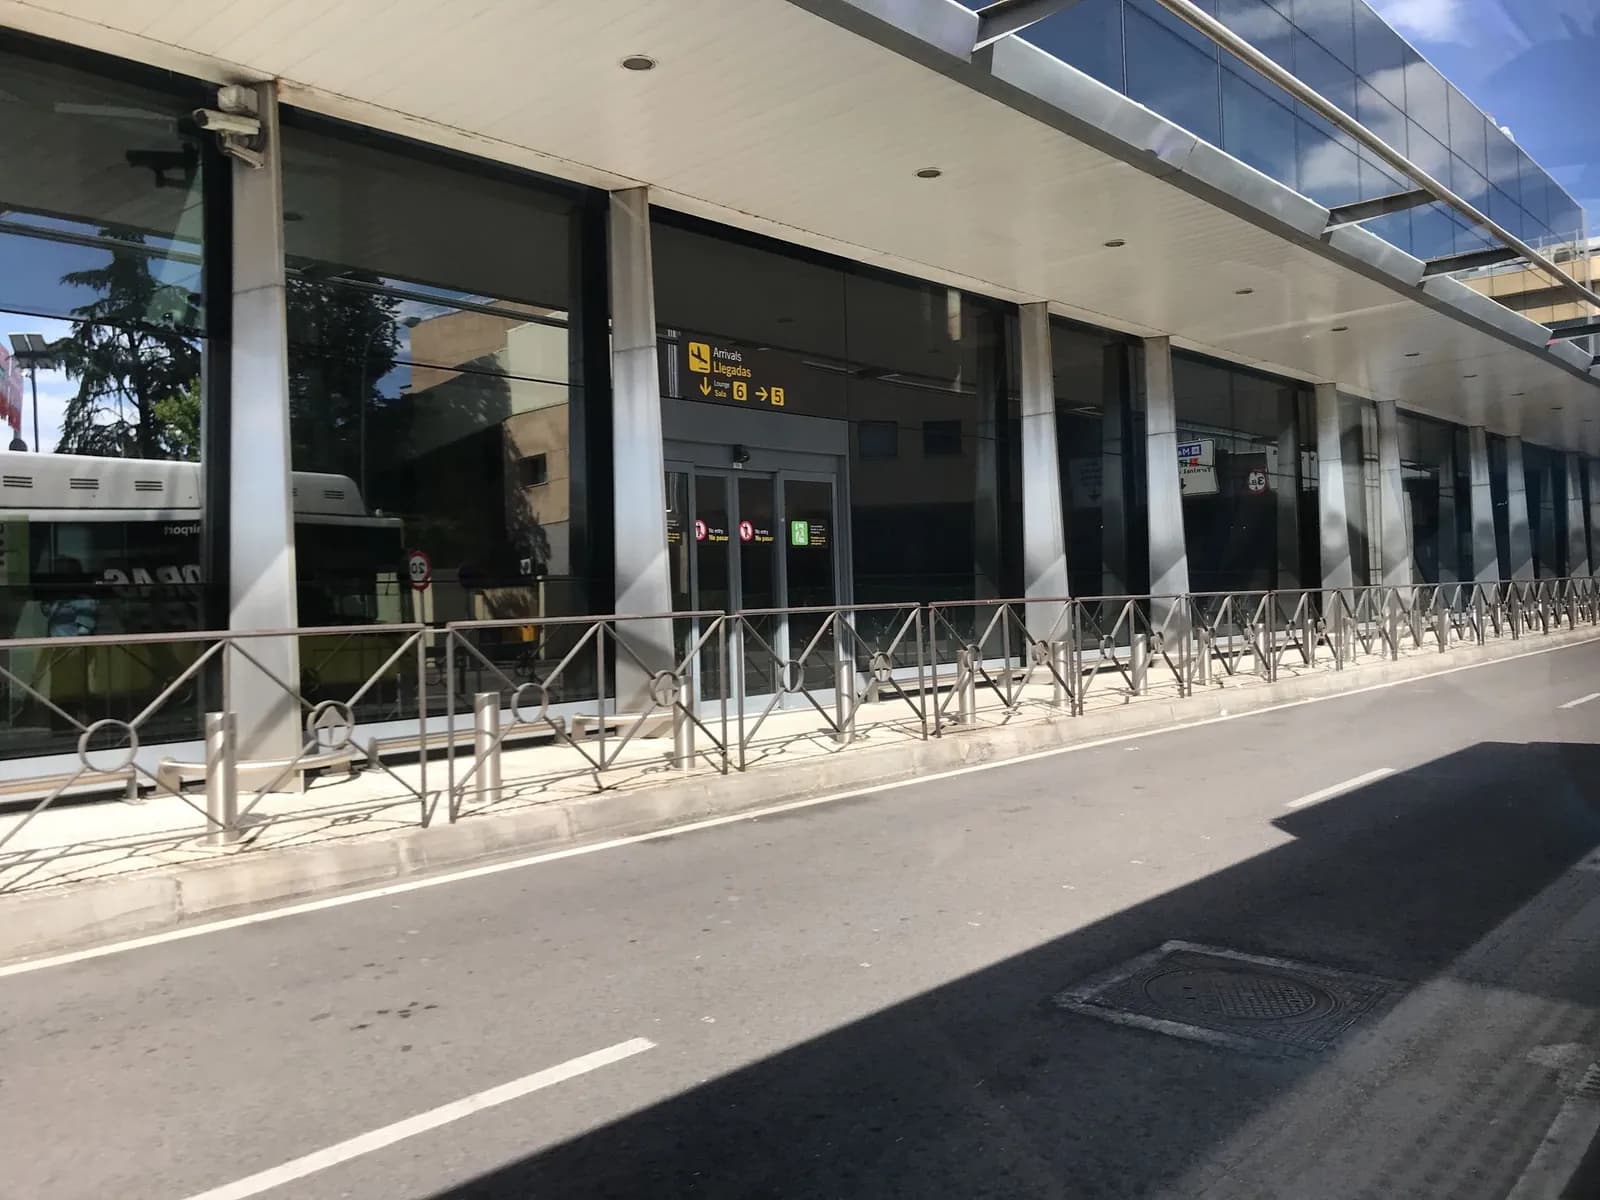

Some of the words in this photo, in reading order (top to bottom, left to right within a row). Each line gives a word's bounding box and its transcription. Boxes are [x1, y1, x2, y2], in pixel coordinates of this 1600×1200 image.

[713, 347, 742, 361] Arrivals
[713, 361, 751, 377] Llegadas
[736, 384, 744, 399] 6
[775, 390, 782, 403] 5
